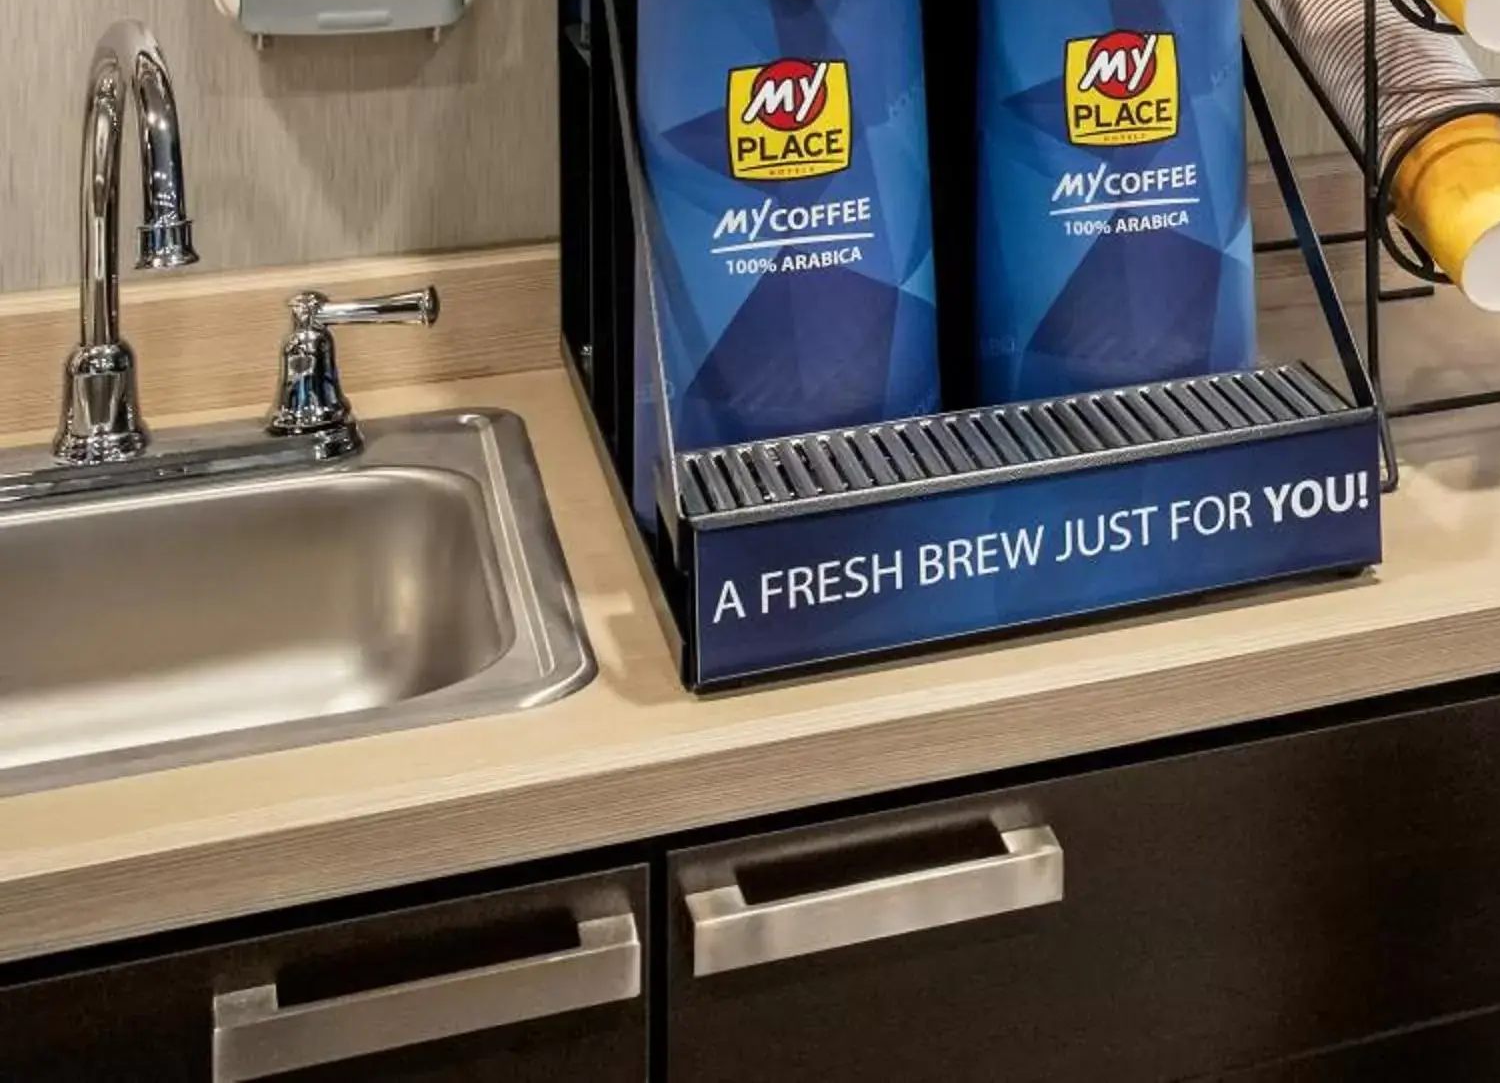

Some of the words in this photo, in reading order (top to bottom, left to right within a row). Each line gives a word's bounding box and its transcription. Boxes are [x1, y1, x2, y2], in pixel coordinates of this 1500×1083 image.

[1073, 98, 1172, 129] PLACE
[736, 128, 844, 162] PLACE
[1063, 221, 1111, 236] 100%
[1115, 209, 1190, 235] ARABICA
[725, 258, 777, 275] 100%
[780, 245, 863, 273] ARABICA
[712, 580, 747, 624] A
[760, 549, 903, 615] FRESH
[918, 524, 1045, 586] BREW
[1055, 505, 1159, 562] JUST
[1170, 490, 1253, 541] FOR
[1263, 470, 1369, 524] YOU!
